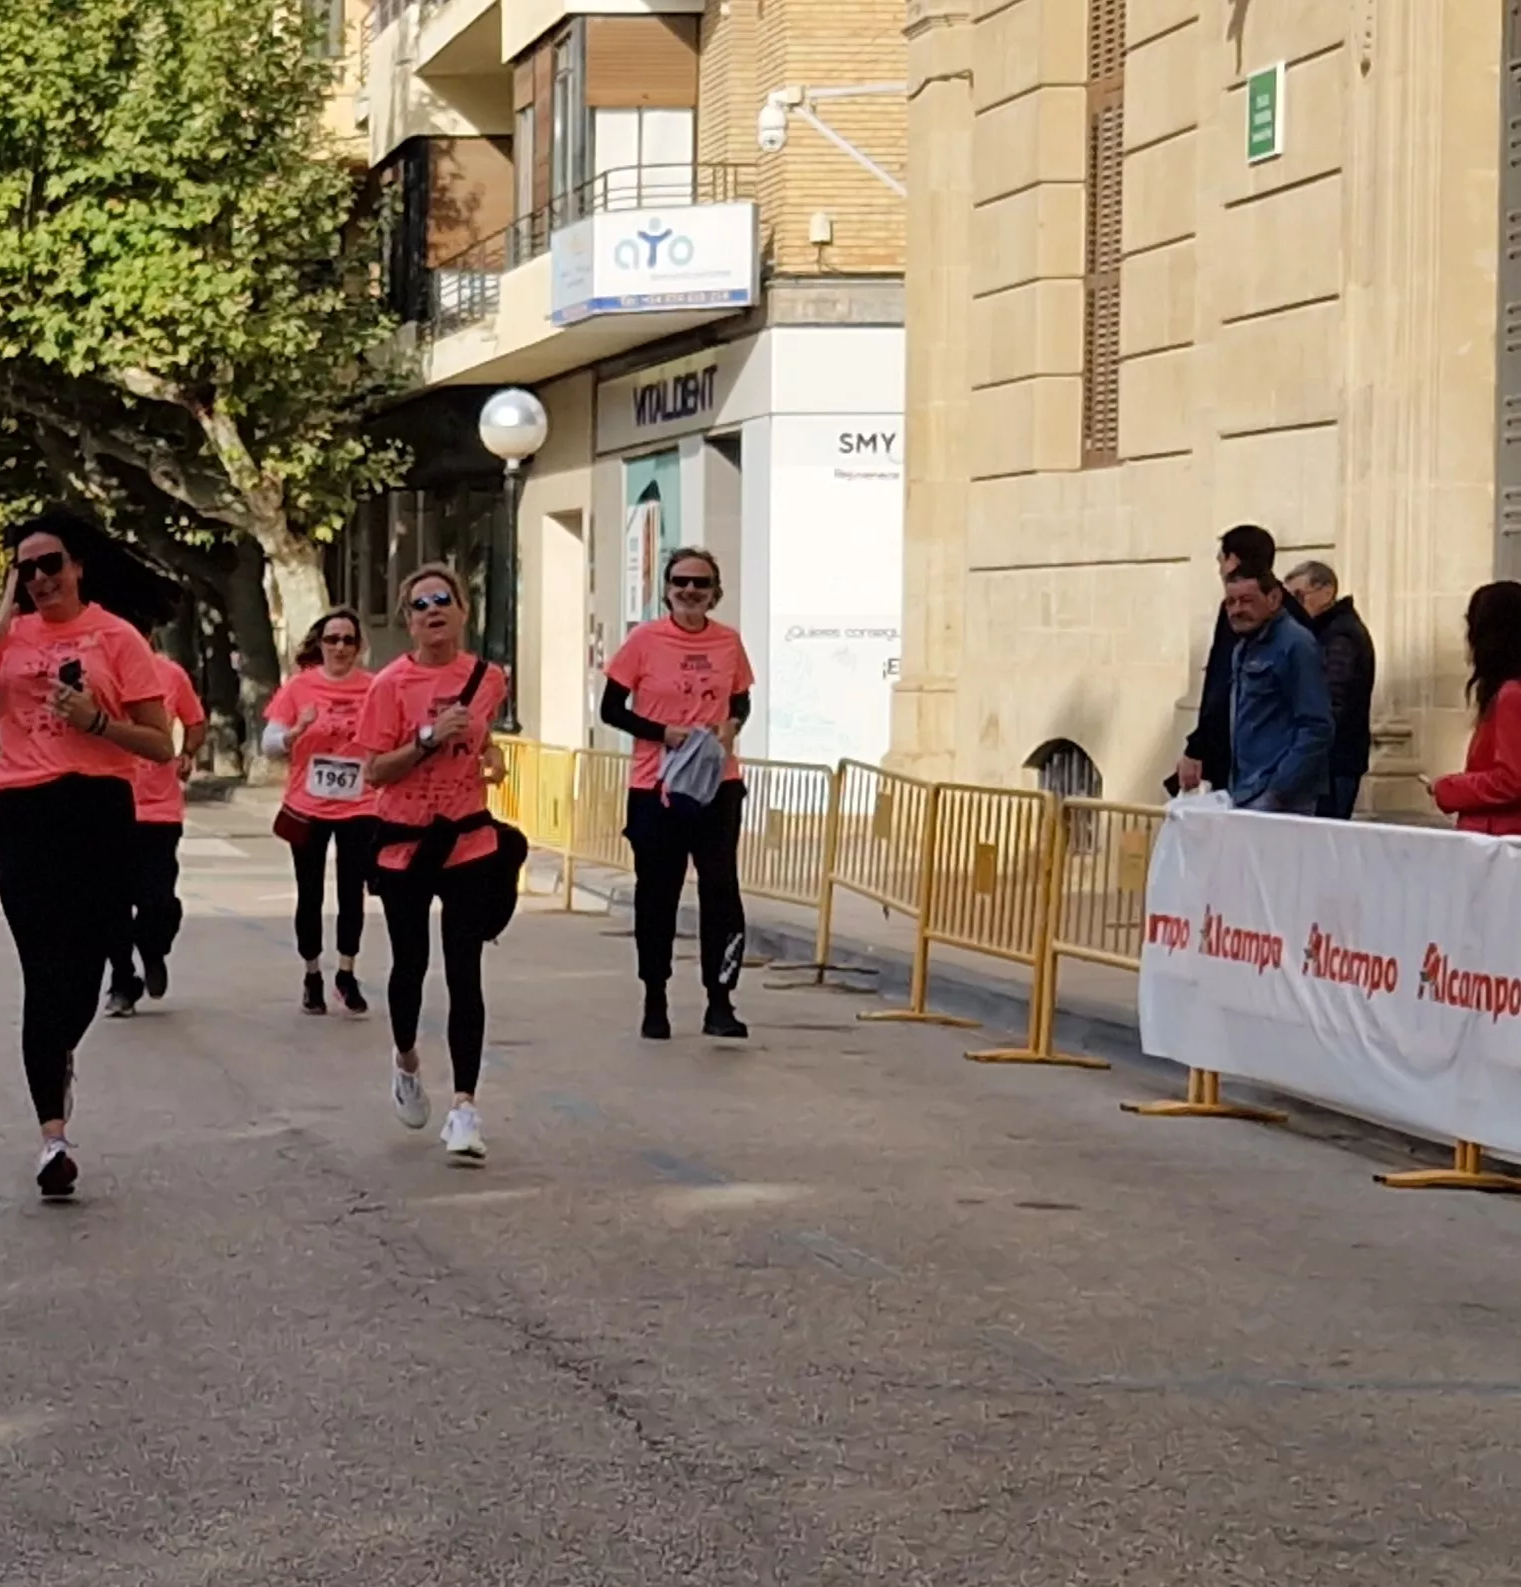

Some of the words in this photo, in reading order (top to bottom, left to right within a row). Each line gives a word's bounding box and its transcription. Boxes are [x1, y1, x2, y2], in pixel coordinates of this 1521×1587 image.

[633, 365, 718, 426] VITALDENT
[315, 769, 359, 788] 1967
[1197, 903, 1283, 976] Alcampo
[1302, 922, 1399, 1000] Alcampo
[1417, 942, 1521, 1024] Alcampo
